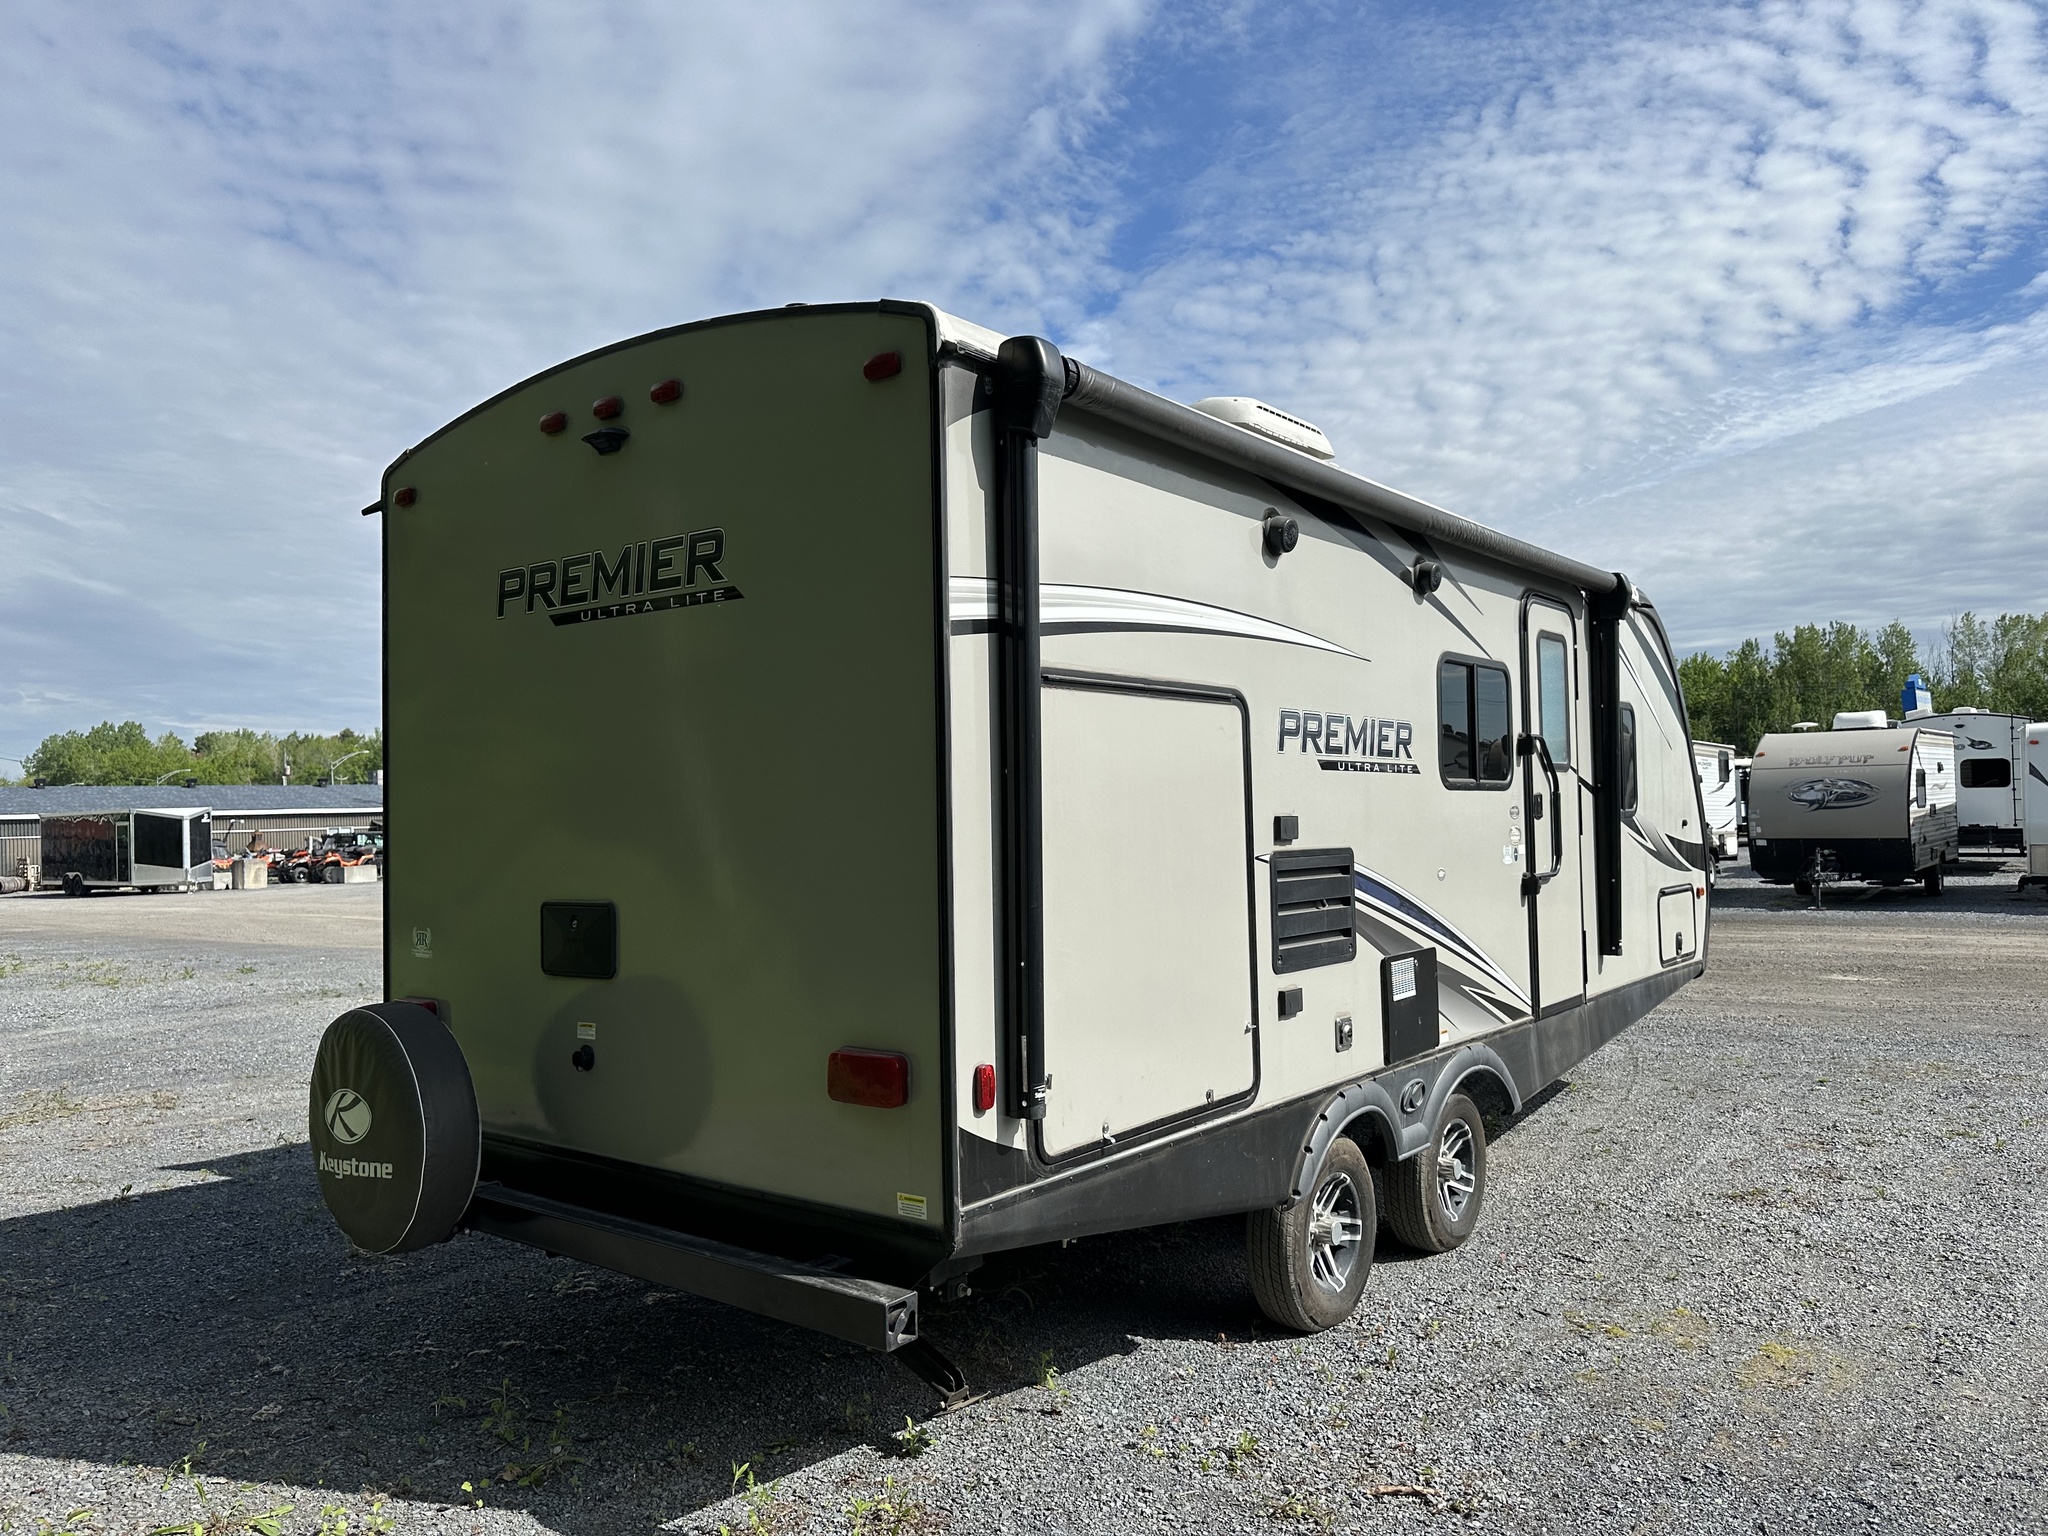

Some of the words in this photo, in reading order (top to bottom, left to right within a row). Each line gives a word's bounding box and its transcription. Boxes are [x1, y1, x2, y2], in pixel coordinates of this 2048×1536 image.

[496, 526, 729, 620] PREMIER
[580, 600, 654, 622] ULTRA
[670, 589, 726, 609] LITE
[1277, 707, 1415, 761] PREMIER
[1337, 761, 1380, 772] ULTRA
[1386, 764, 1414, 774] LITE
[319, 1150, 394, 1180] Keystone
